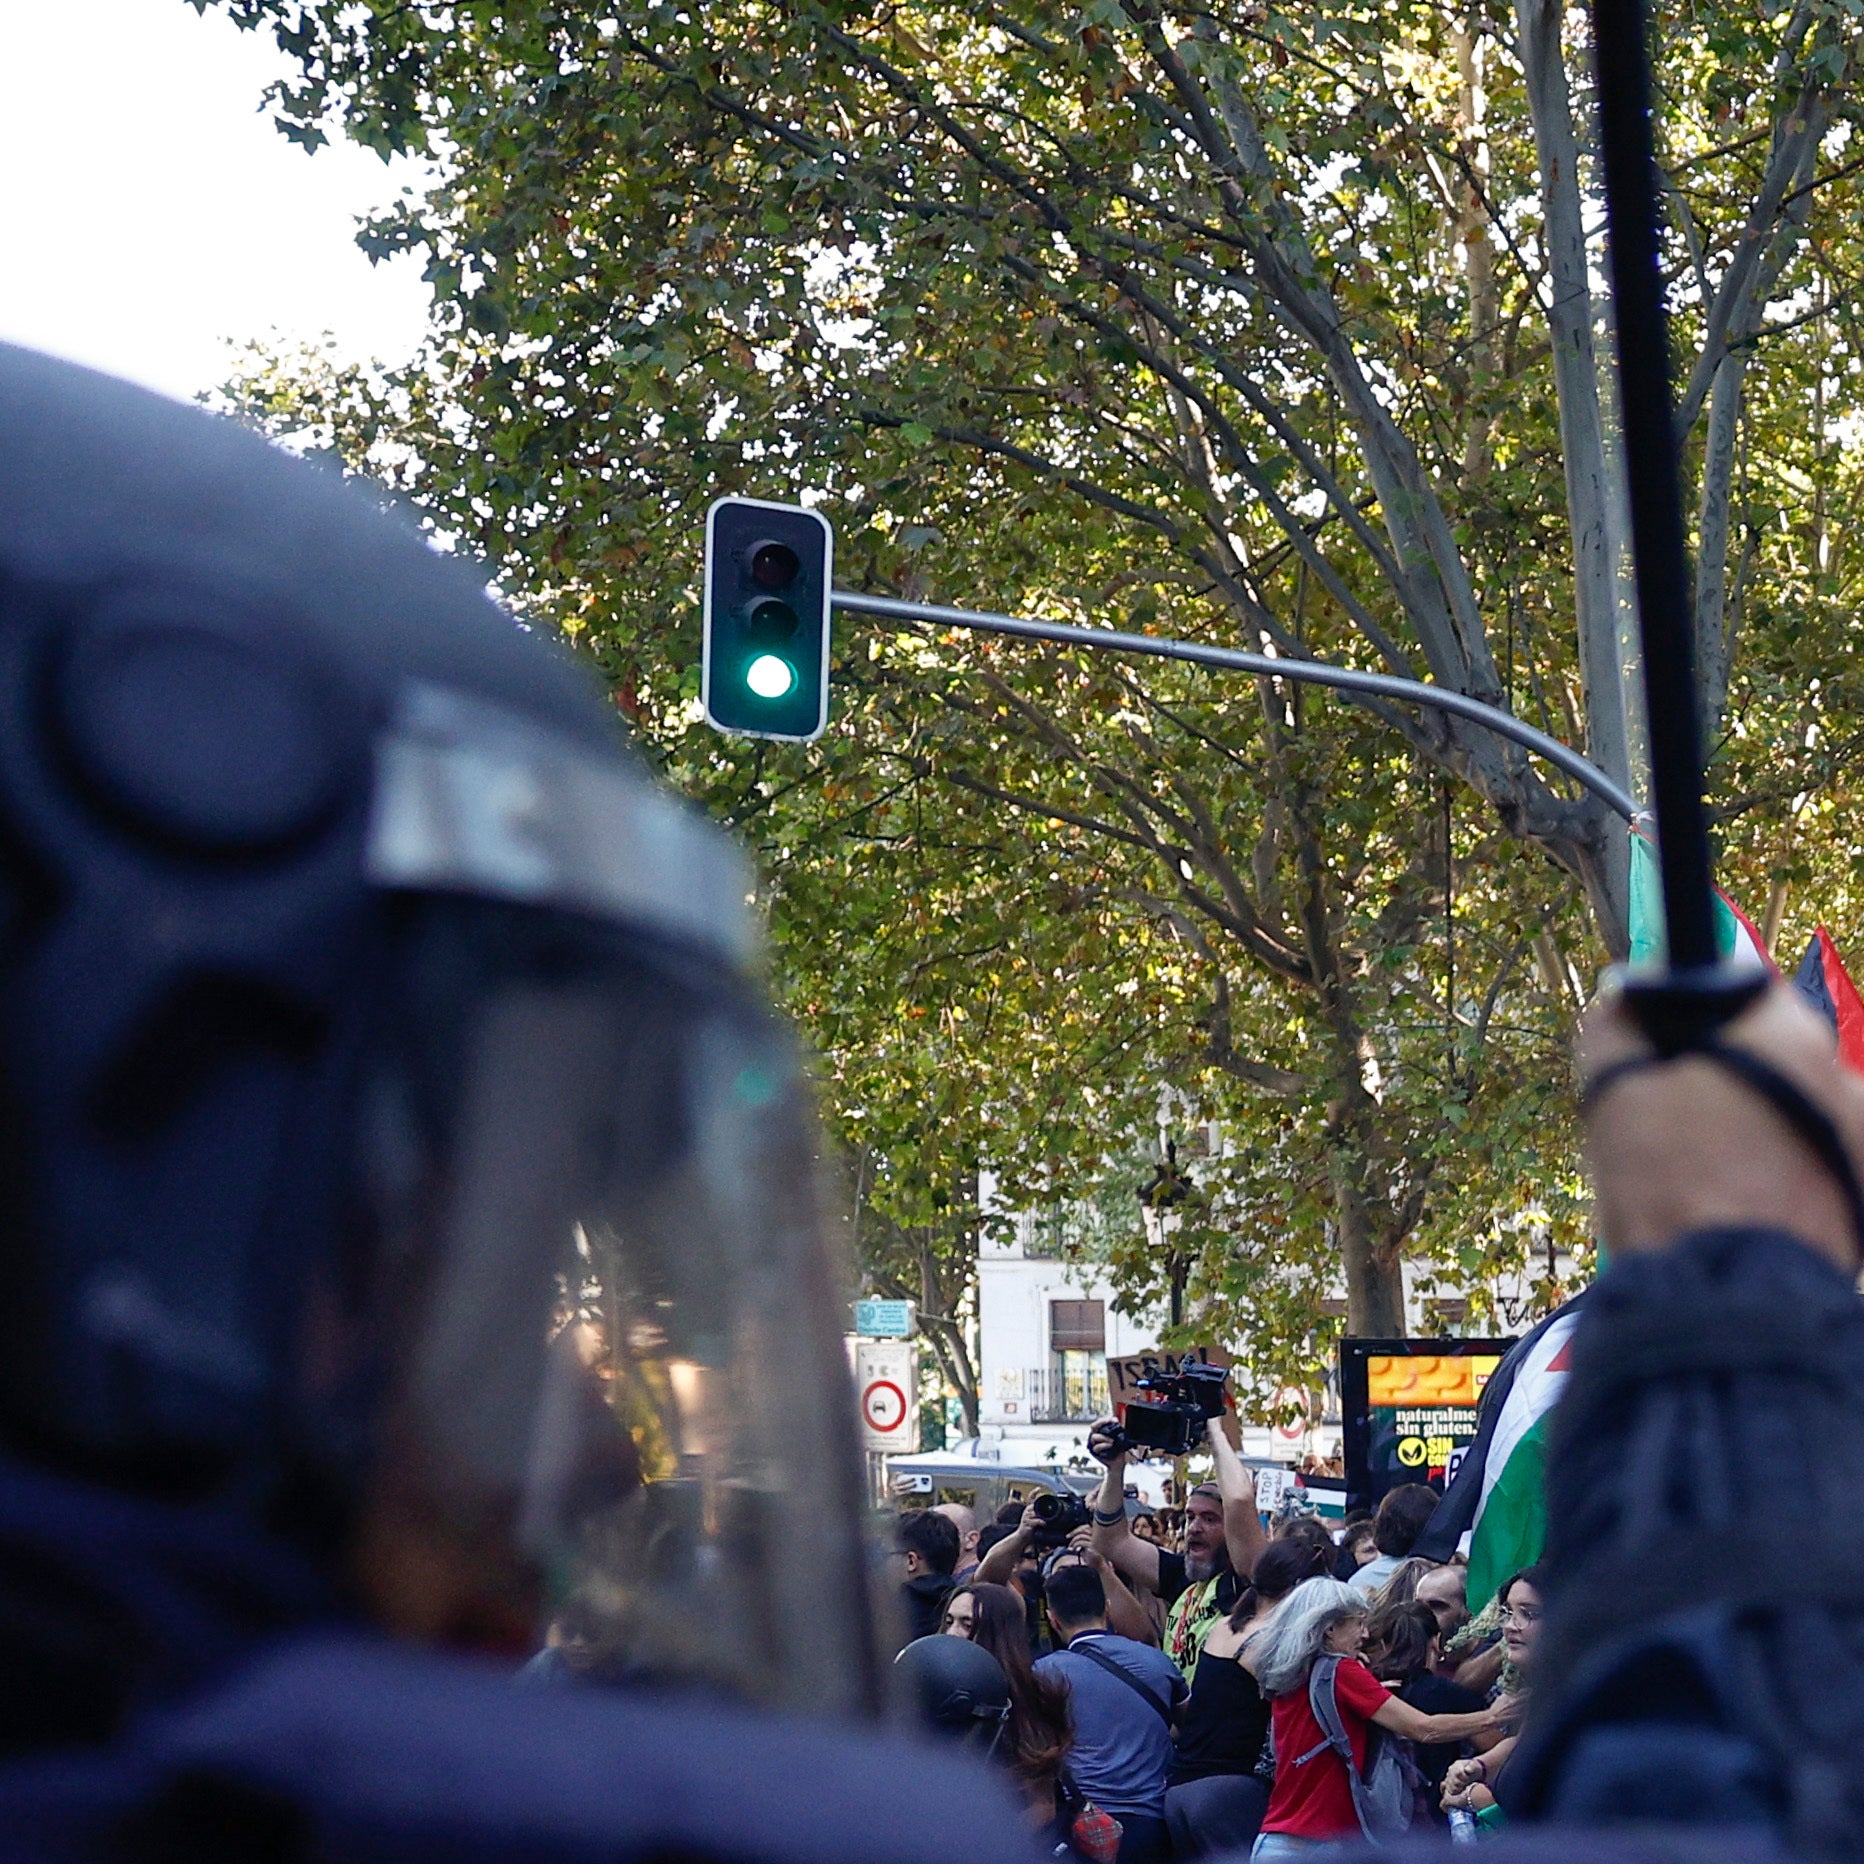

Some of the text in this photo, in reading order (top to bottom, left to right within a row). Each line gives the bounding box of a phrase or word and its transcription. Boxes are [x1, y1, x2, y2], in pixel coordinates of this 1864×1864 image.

[1396, 1406, 1478, 1423] naturalme
[1396, 1421, 1478, 1438] sin gluten.
[1426, 1437, 1453, 1451] SIN
